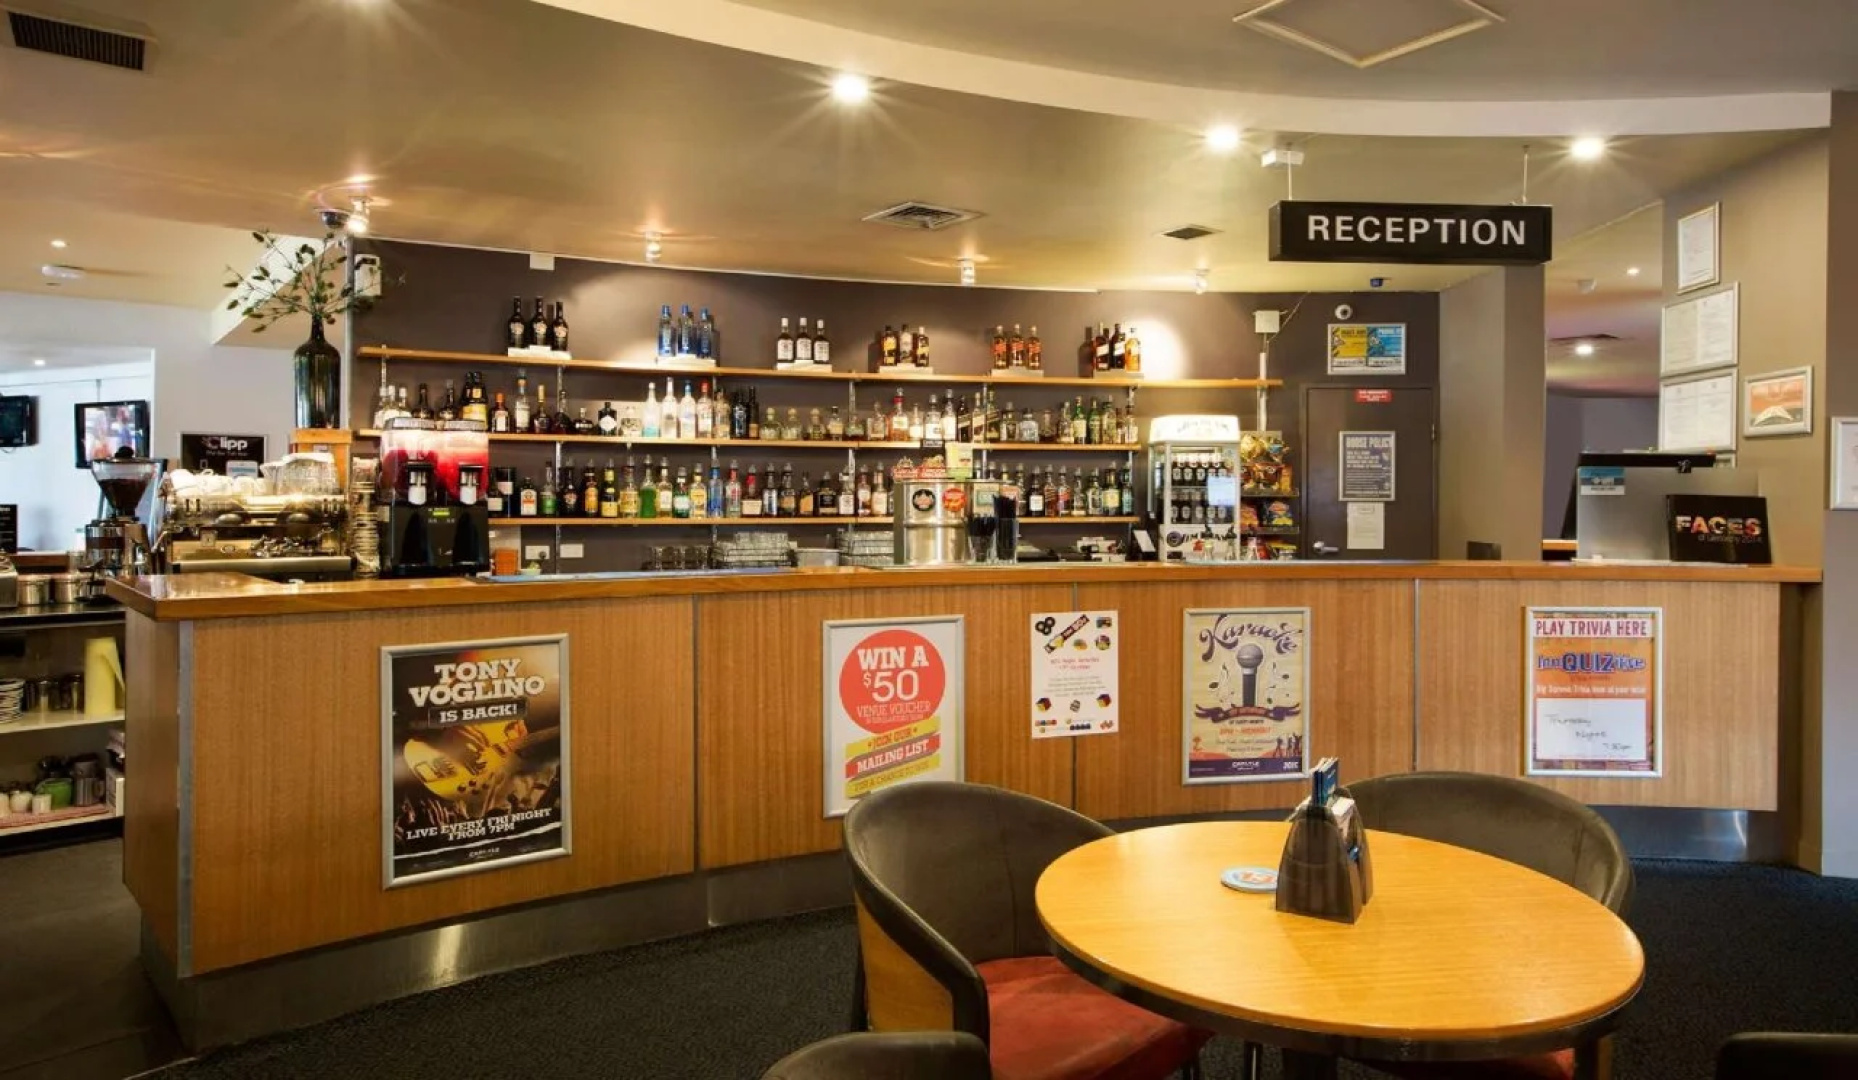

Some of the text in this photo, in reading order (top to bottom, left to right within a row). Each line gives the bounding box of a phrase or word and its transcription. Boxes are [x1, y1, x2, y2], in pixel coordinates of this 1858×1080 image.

[1307, 214, 1525, 245] RECEPTION
[207, 436, 248, 451] Clipp
[1675, 515, 1762, 536] FACES
[1199, 614, 1304, 662] Karaoke
[1536, 620, 1647, 635] PLAY TRIVIA HERE
[857, 645, 930, 670] WIN A
[434, 658, 522, 684] TONY
[408, 675, 546, 708] VOGLINO
[863, 668, 920, 703] $50
[440, 703, 518, 723] IS BACK!
[856, 700, 931, 718] VENUE VOUCHER
[857, 738, 930, 773] MAILING LIST
[407, 808, 552, 840] LIVE EVERY FRI NIGHT
[448, 822, 516, 842] FROM 7PM
